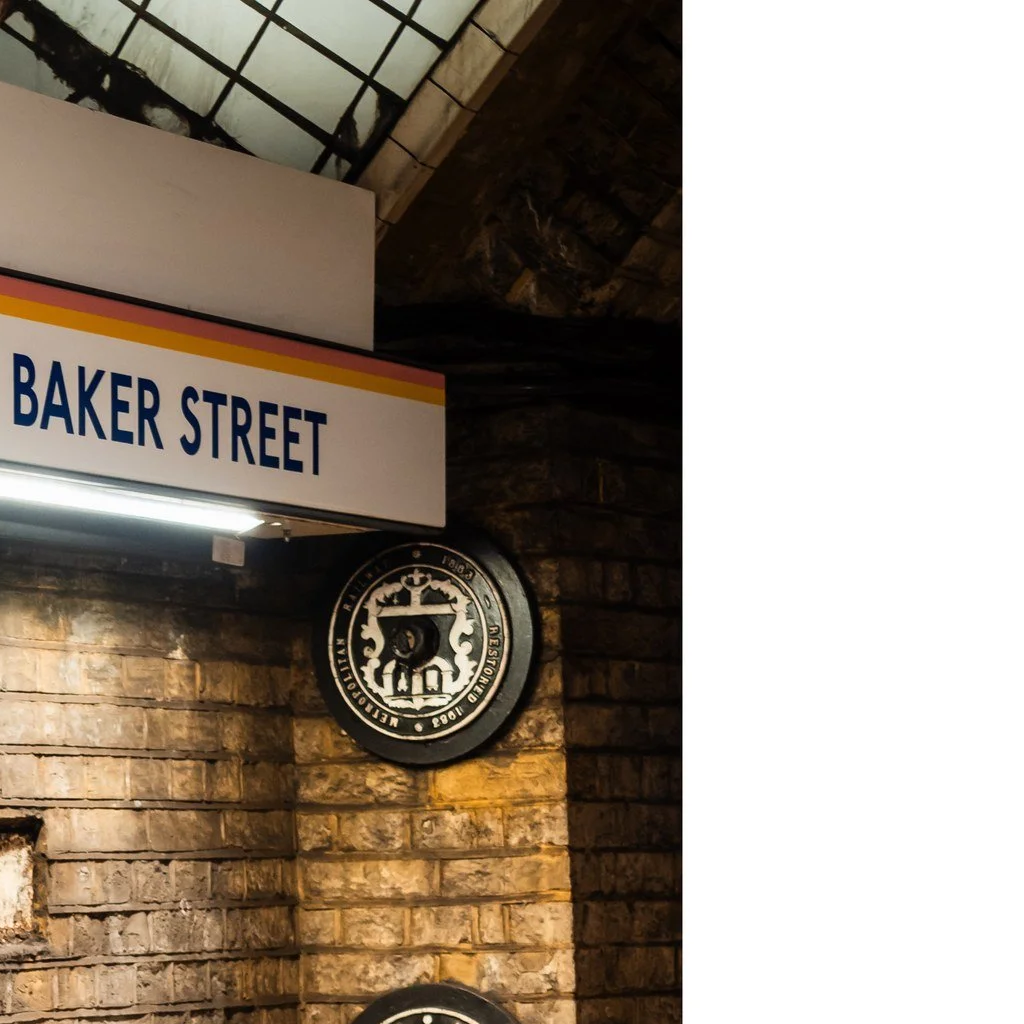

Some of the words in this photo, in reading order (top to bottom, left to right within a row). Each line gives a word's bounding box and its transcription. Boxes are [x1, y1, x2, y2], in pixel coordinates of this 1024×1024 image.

[13, 352, 164, 450] BAKER
[179, 385, 327, 476] STREET
[336, 638, 399, 728] METROPOLITAN
[467, 625, 501, 704] RESTORED
[431, 707, 465, 728] 1983
